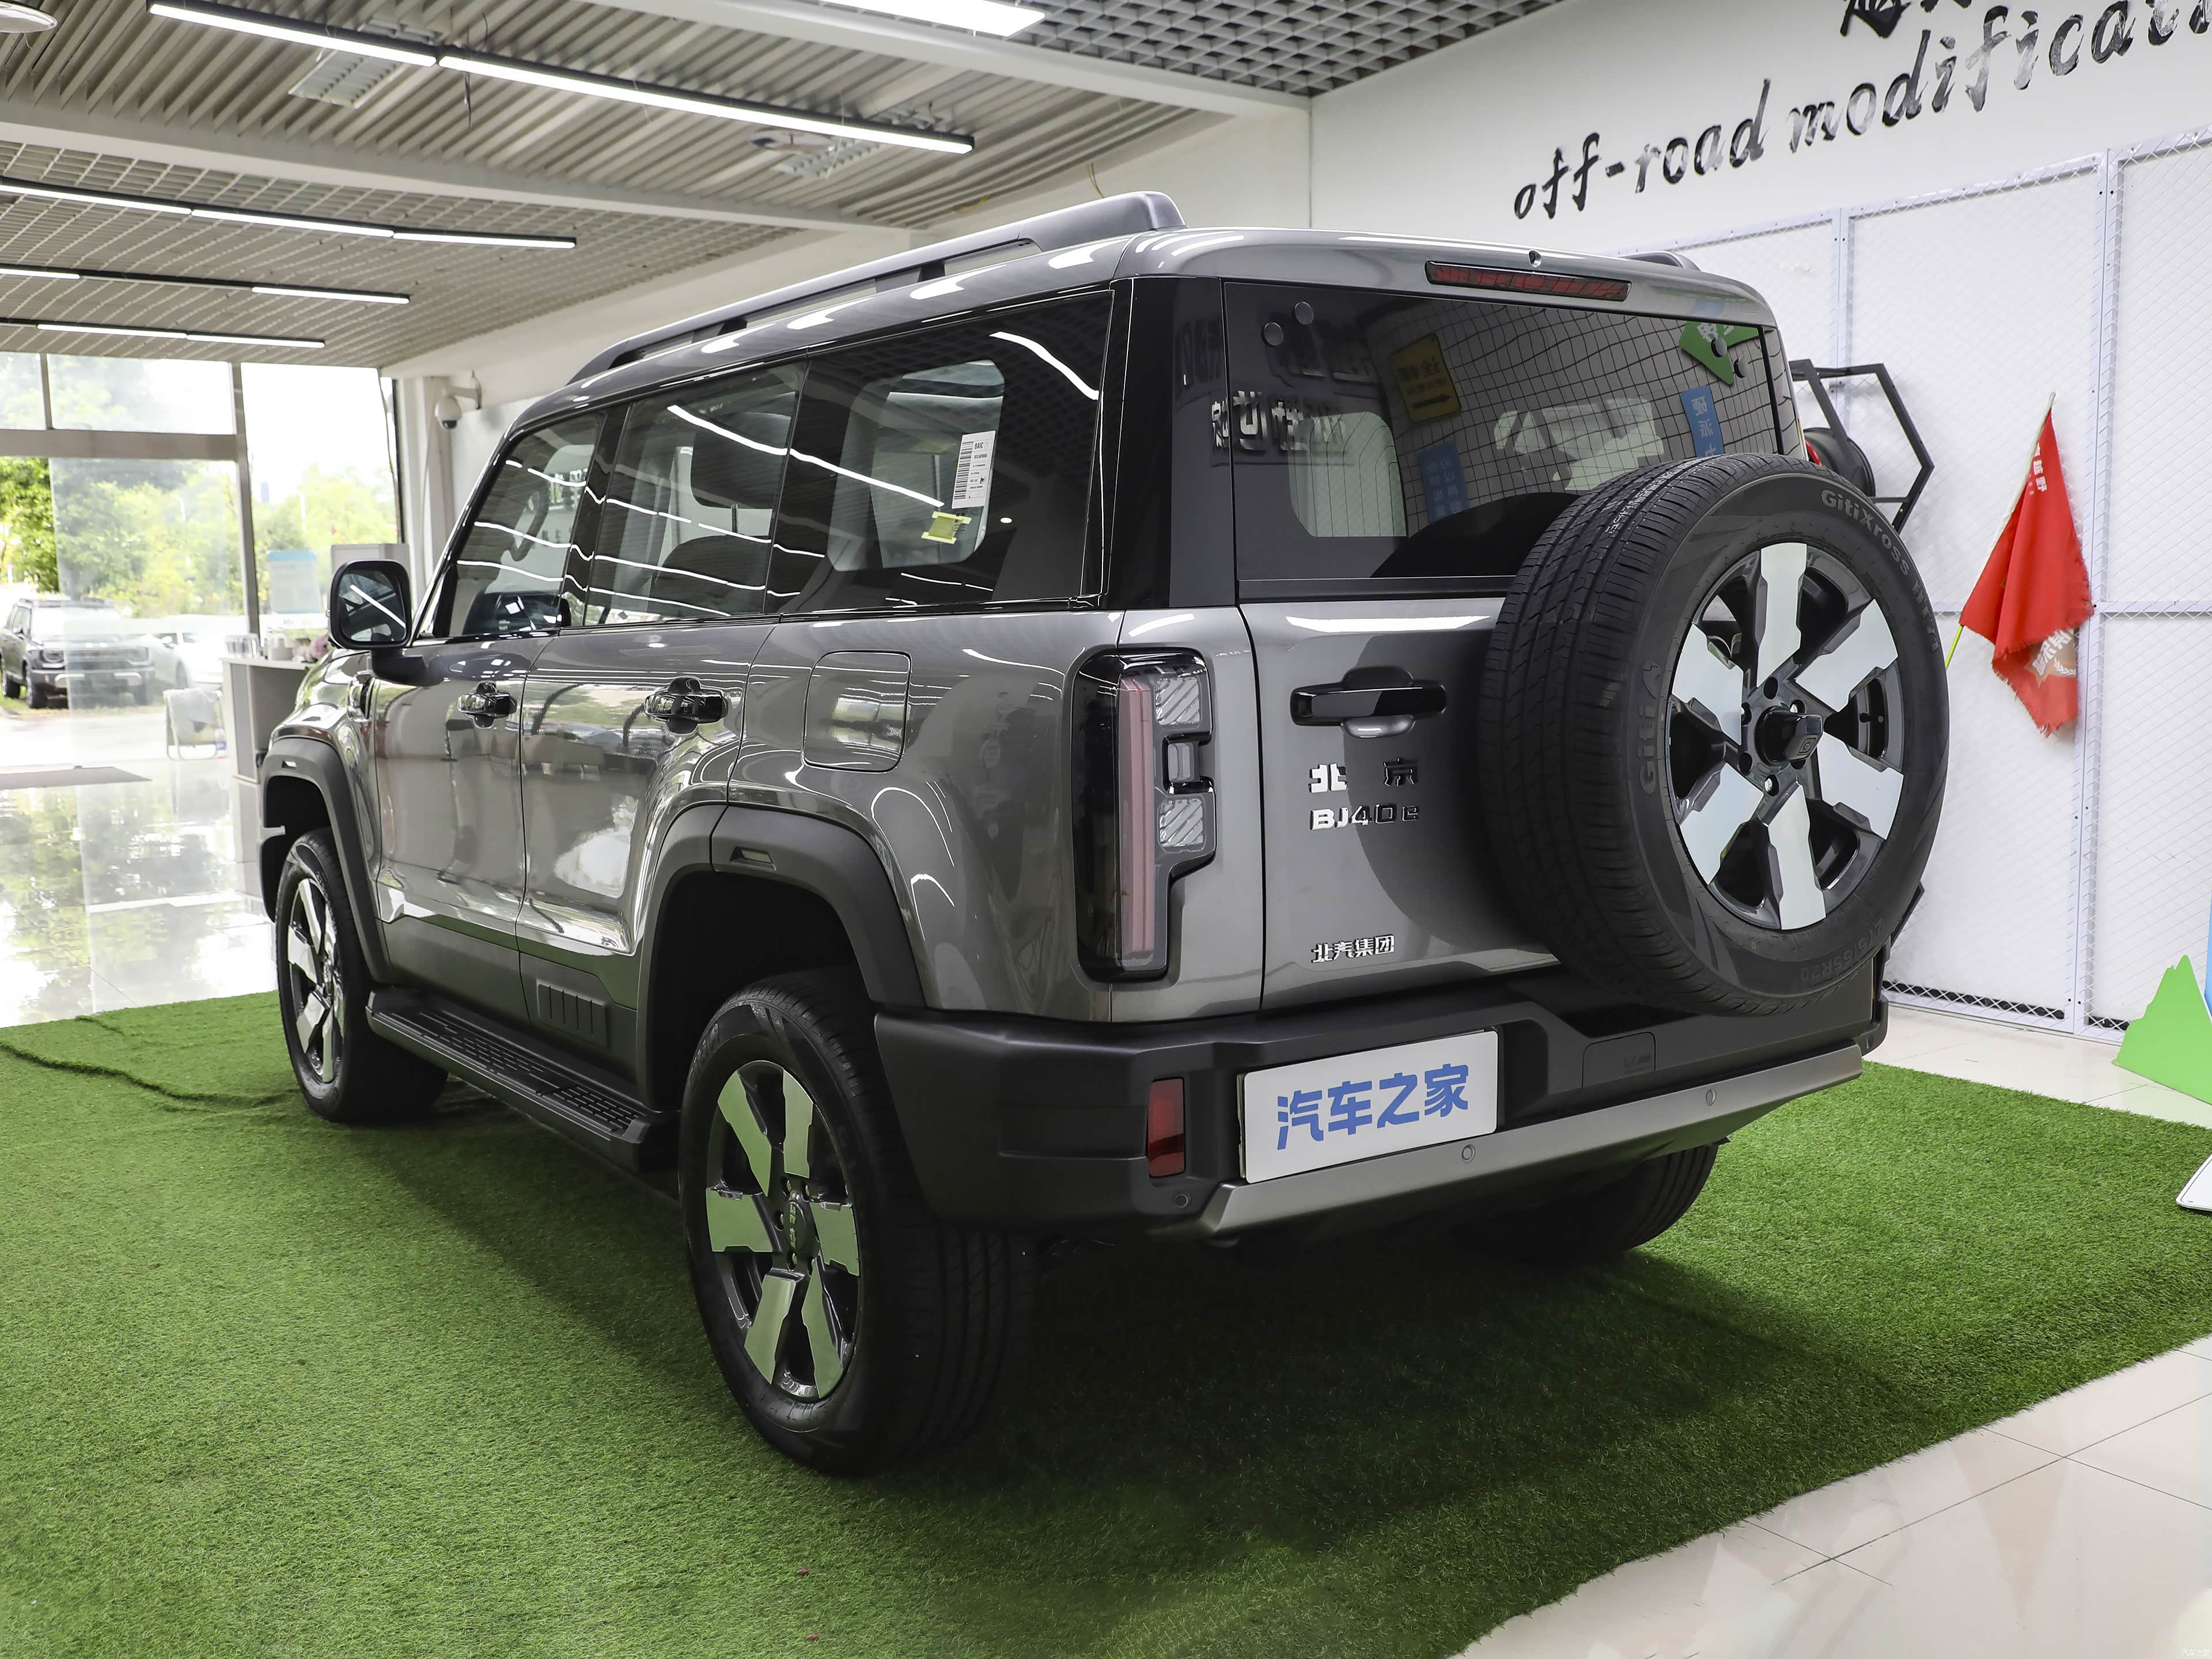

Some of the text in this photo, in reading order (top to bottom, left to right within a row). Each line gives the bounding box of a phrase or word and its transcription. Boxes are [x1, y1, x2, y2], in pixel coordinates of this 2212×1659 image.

[1514, 78, 1770, 219] off-road
[1821, 489, 1910, 576] GitiXross
[1308, 757, 1418, 793] 北京
[1637, 704, 1656, 794] Giti
[1311, 934, 1396, 964] 北汽集团
[1277, 1063, 1469, 1151] 汽车之家
